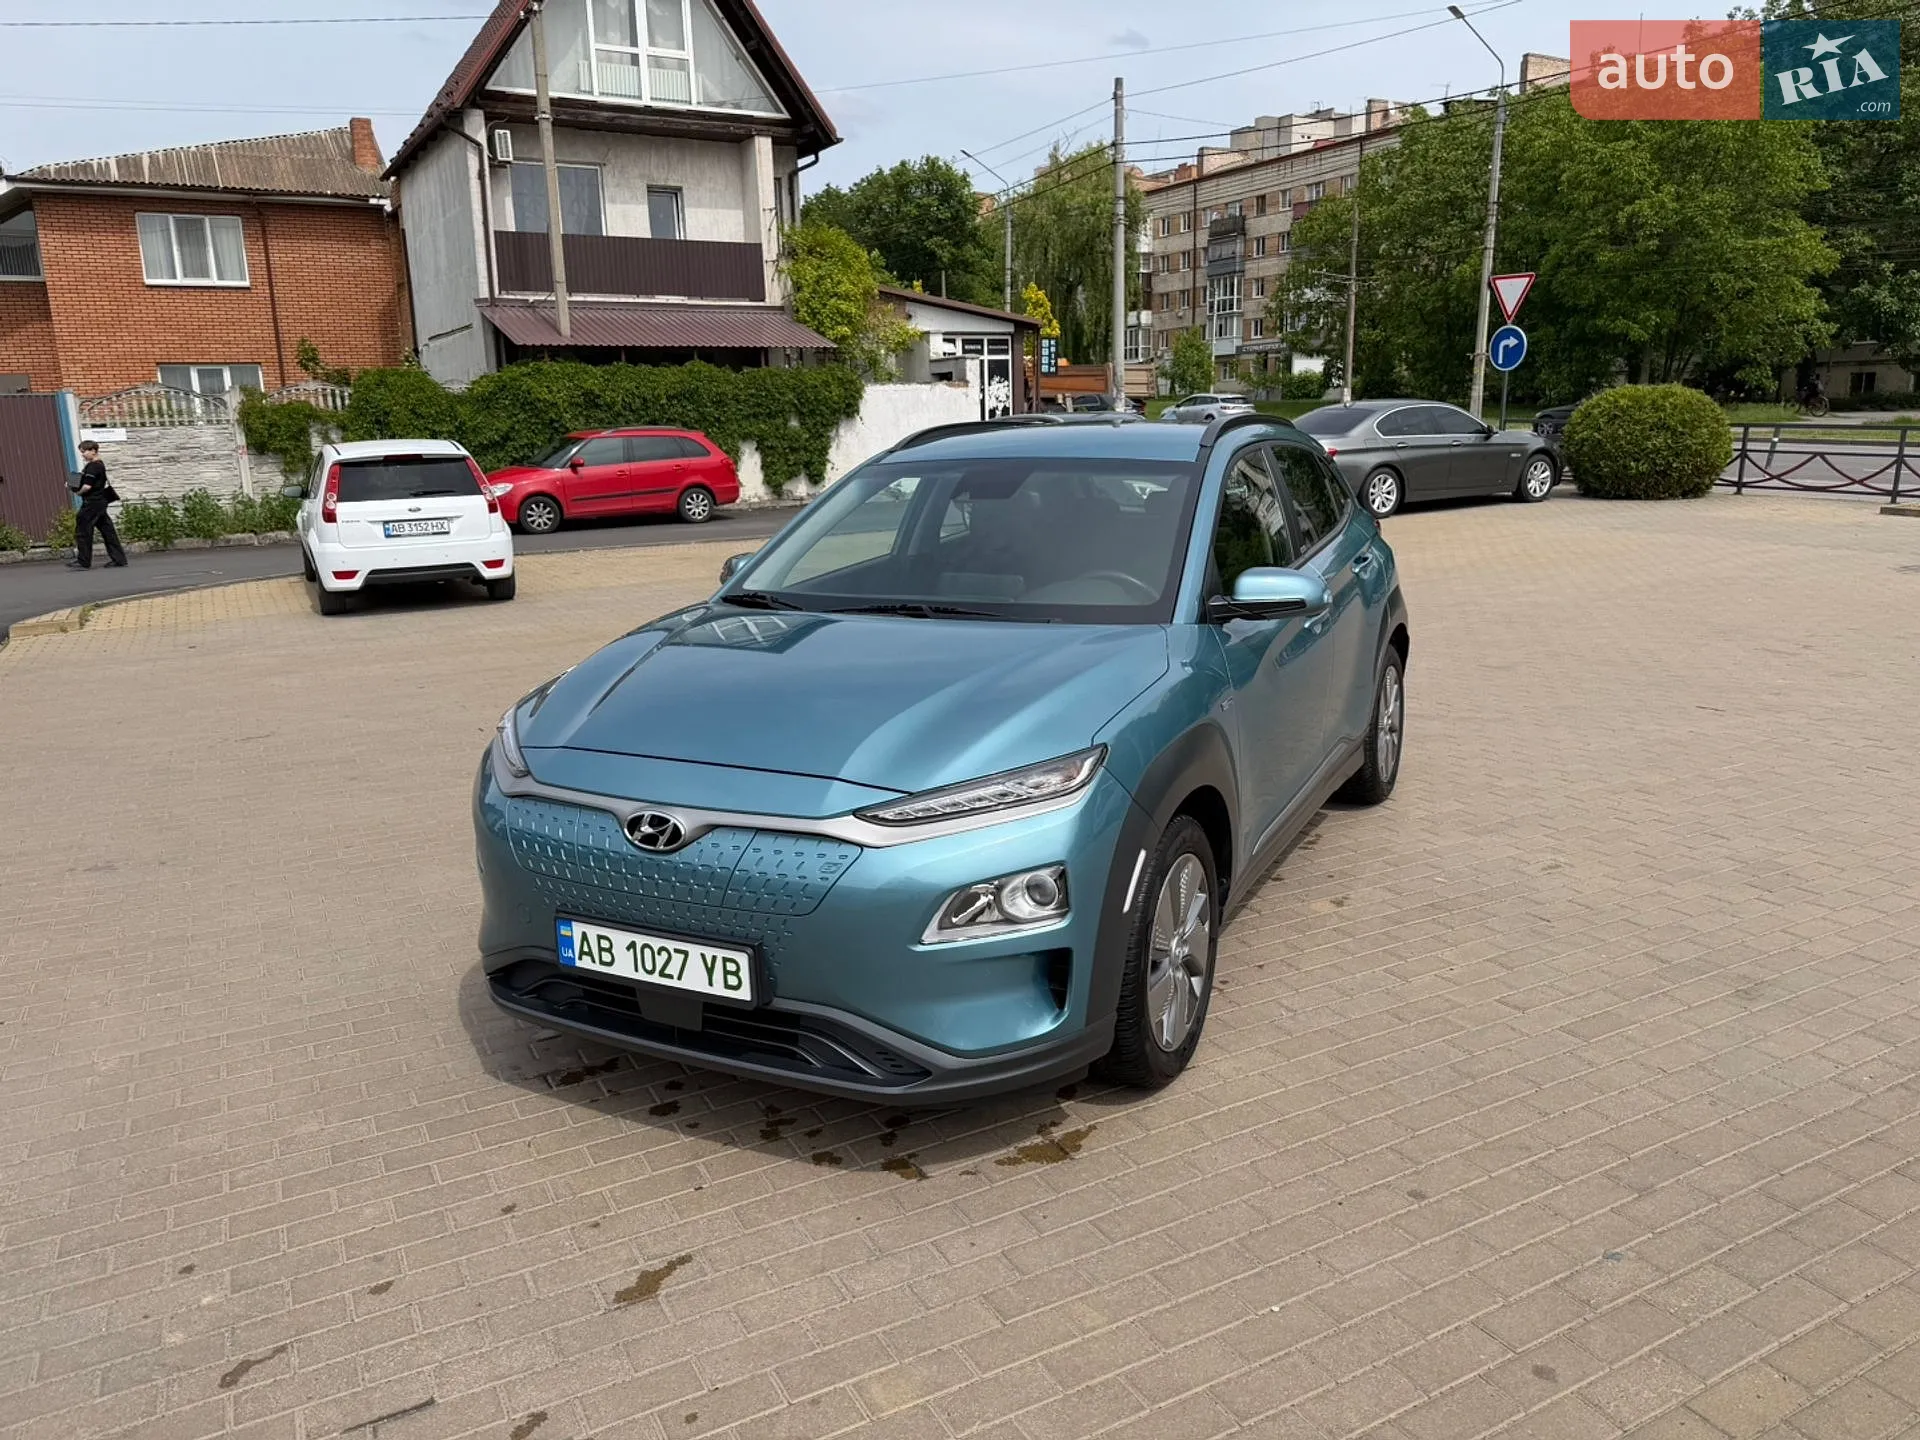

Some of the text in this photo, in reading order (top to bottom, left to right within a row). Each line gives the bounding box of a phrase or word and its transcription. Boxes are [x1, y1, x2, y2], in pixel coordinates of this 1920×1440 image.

[392, 521, 447, 533] AB 3152 HX
[561, 947, 574, 958] UA
[577, 931, 743, 991] AB 1027 YB
